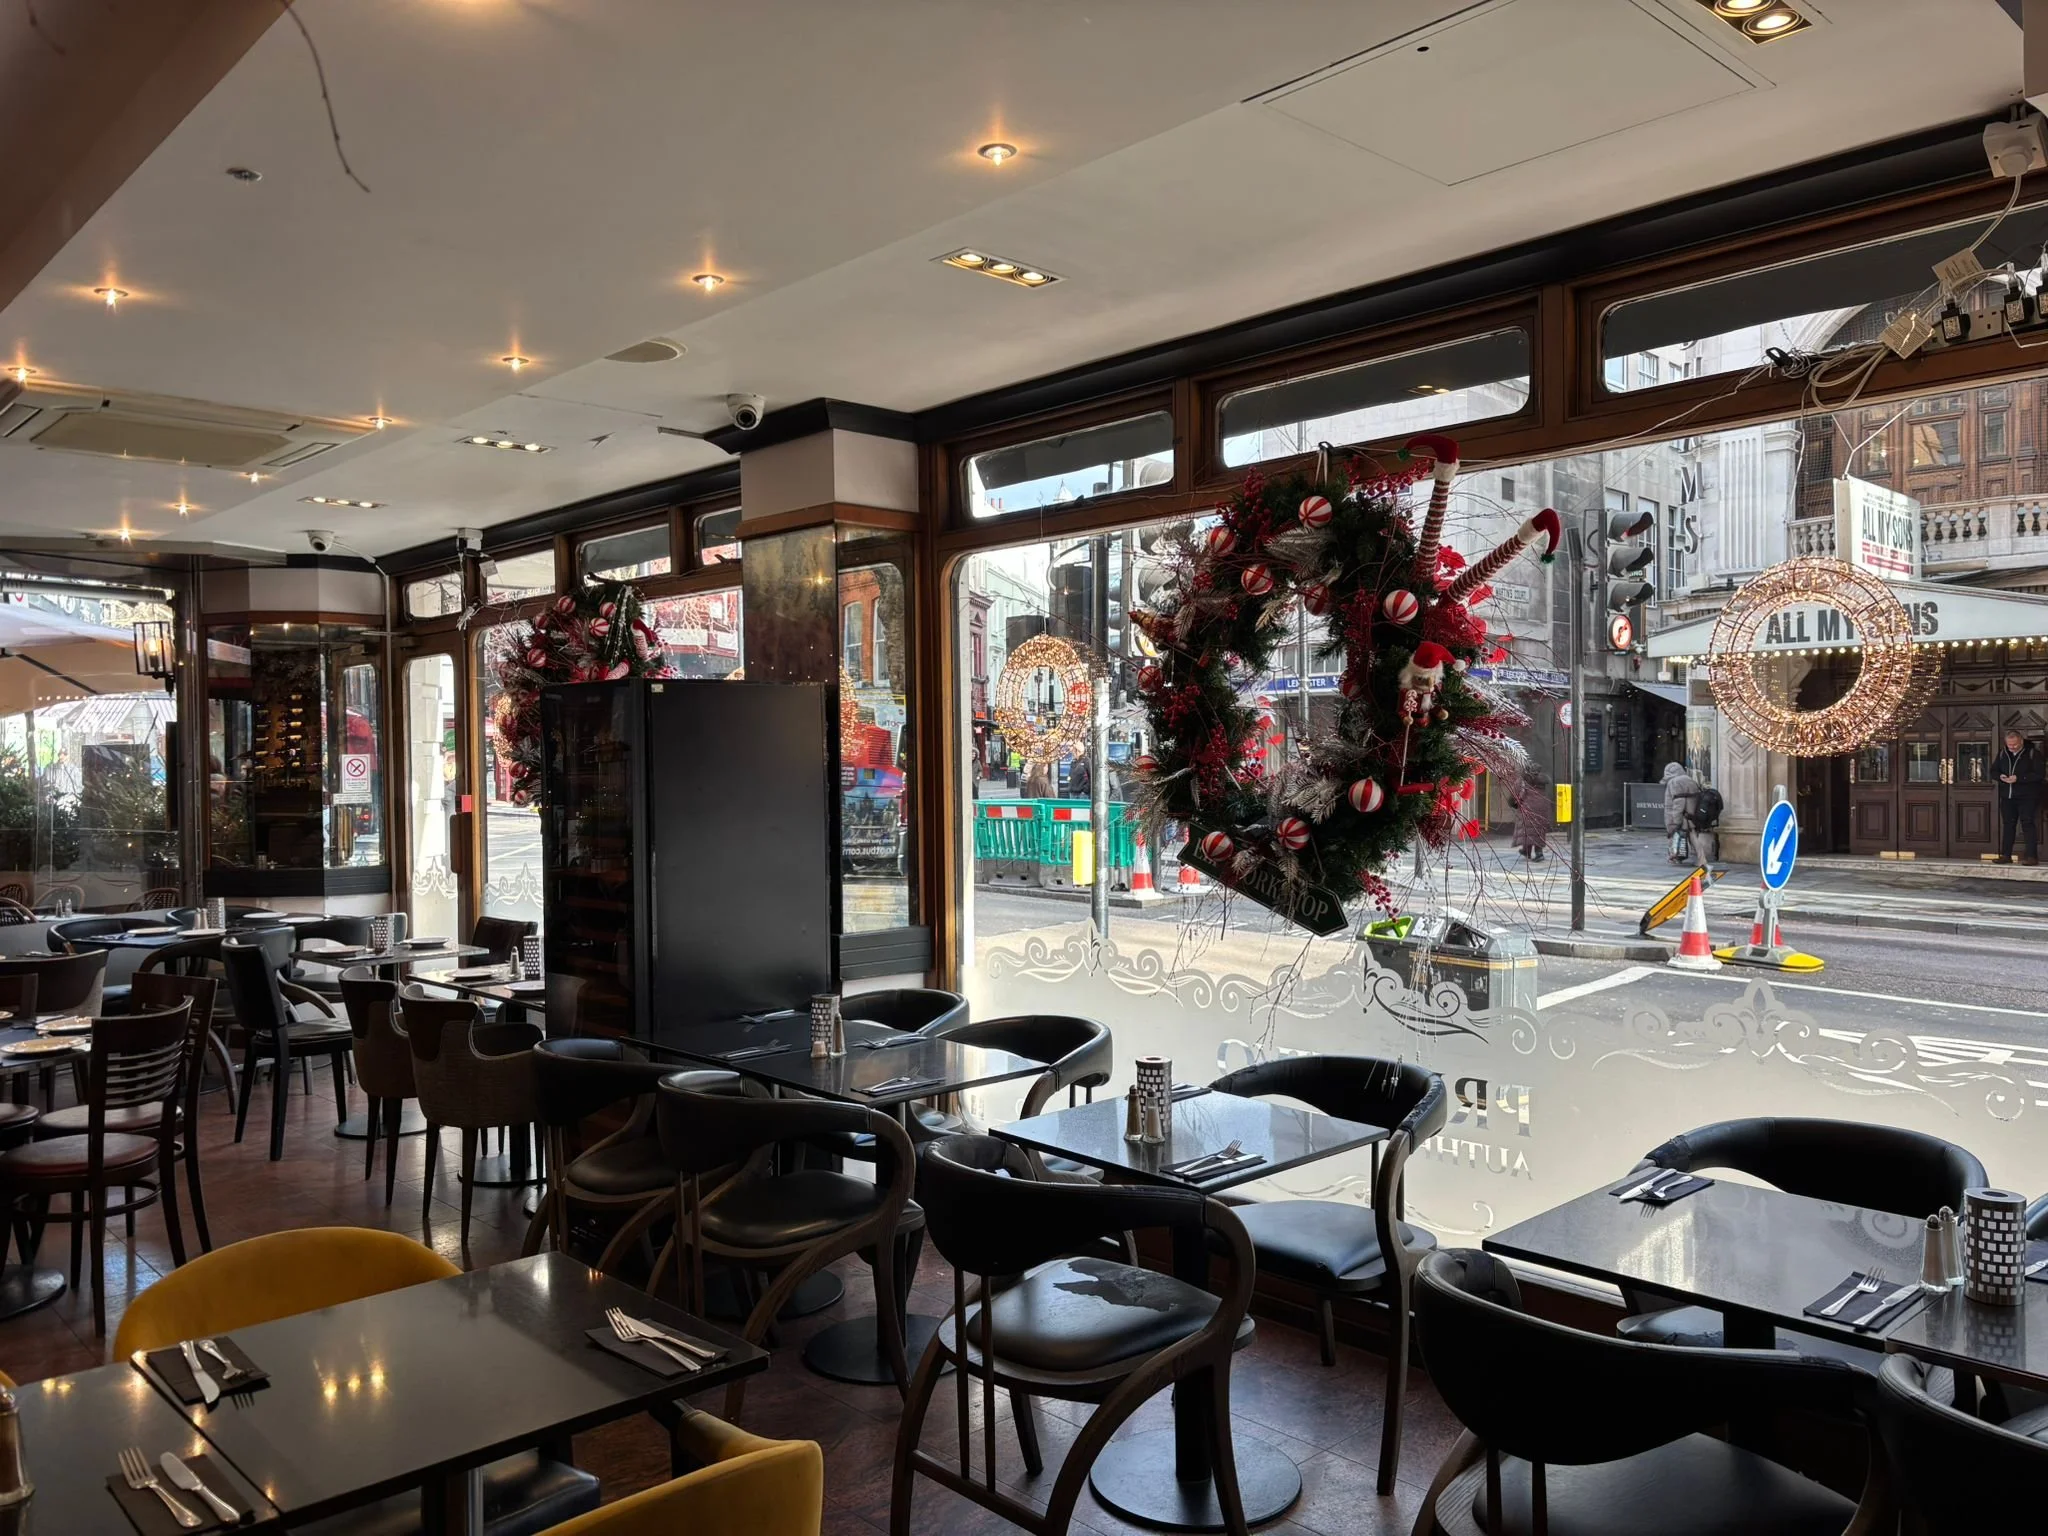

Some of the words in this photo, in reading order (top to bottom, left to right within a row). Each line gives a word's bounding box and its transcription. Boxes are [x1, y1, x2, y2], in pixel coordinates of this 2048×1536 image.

[1862, 504, 1876, 542] ALL
[1878, 509, 1891, 546] MY
[1892, 515, 1914, 552] SONS
[1765, 611, 1811, 645] ALL
[1817, 609, 1857, 642] MY
